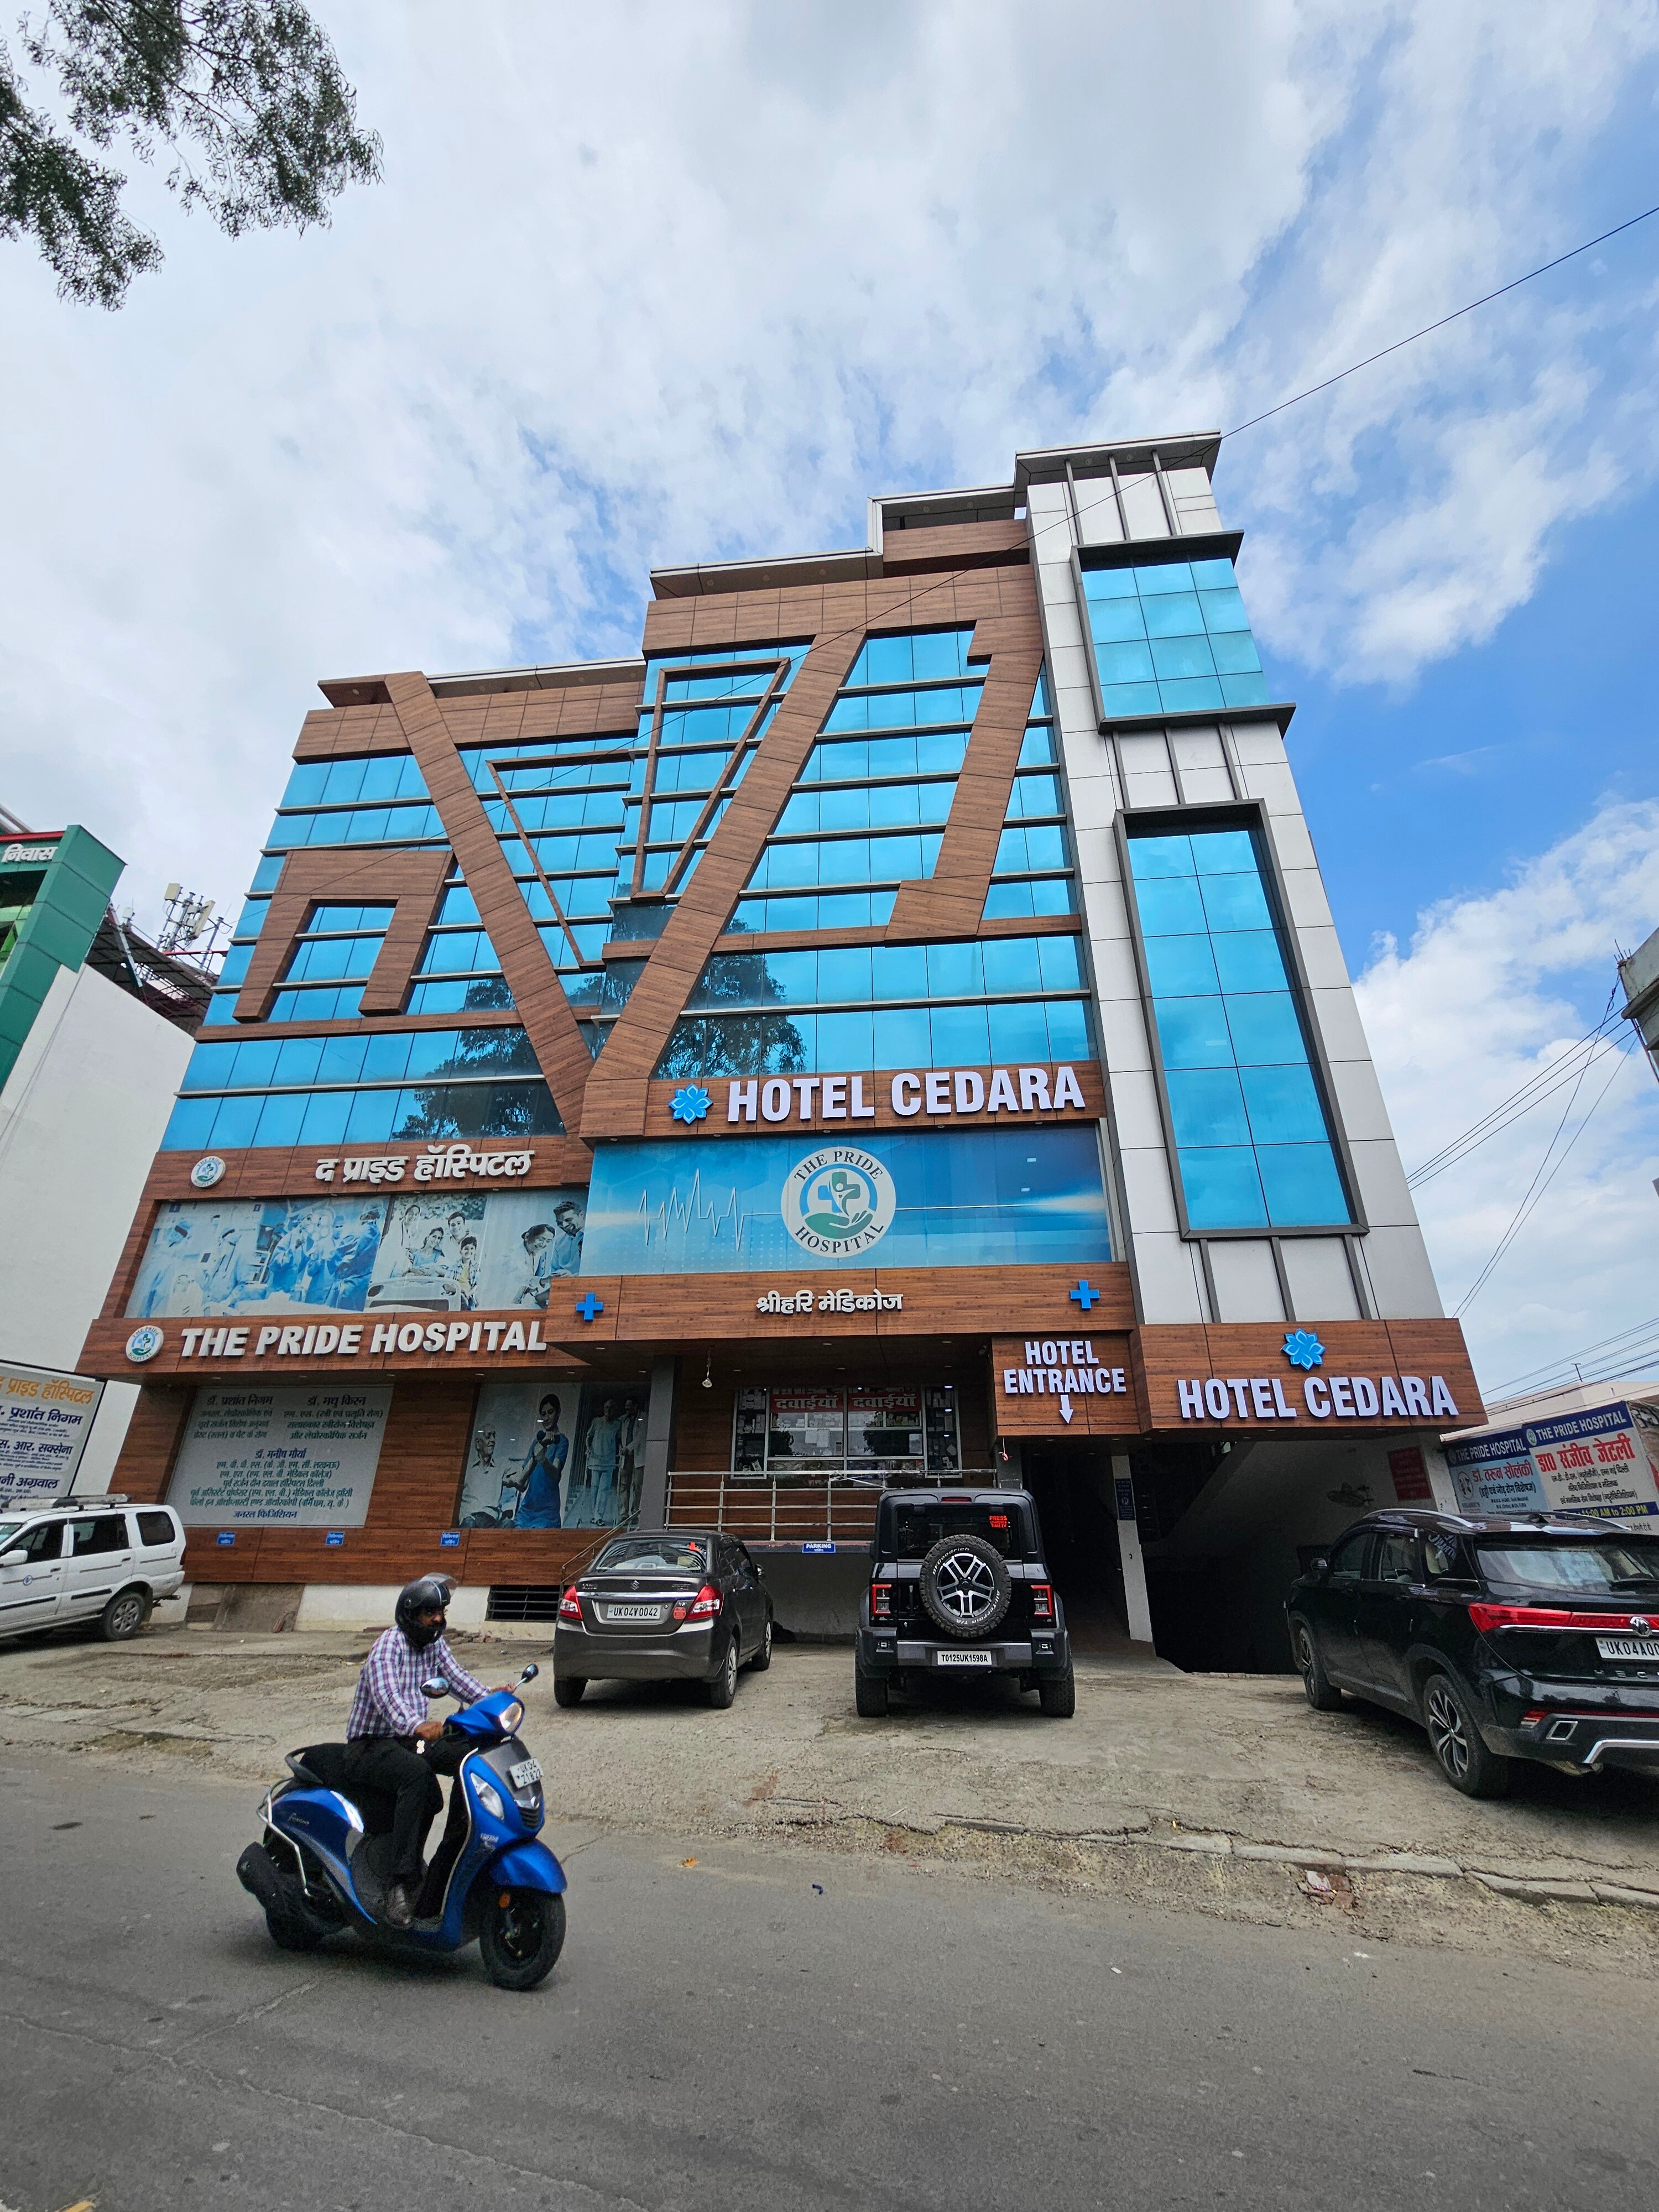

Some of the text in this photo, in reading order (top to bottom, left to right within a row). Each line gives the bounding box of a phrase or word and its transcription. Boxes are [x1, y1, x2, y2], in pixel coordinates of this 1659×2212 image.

[1, 843, 58, 863] निवास
[727, 1066, 1086, 1122] HOTEL CEDARA
[315, 1144, 536, 1184] द प्राइड हॉस्पिटल
[794, 1150, 884, 1182] THE PRIDE
[794, 1224, 885, 1253] HOSPITAL
[756, 1288, 904, 1314] श्रीहरि मेडिकोज
[181, 1320, 547, 1357] THE PRIDE HOSPITAL
[1024, 1339, 1099, 1365] HOTEL
[1003, 1368, 1127, 1395] ENTRANCE
[1177, 1375, 1460, 1419] HOTEL CEDARA
[9, 1406, 46, 1421] प्रशांत
[47, 1408, 84, 1425] निगम
[1535, 1428, 1553, 1441] THE
[1554, 1421, 1580, 1437] PRIDE
[1580, 1410, 1627, 1432] HOSPITAL
[1469, 1444, 1490, 1460] PRIDE
[1490, 1438, 1527, 1457] HOSPITAL
[1557, 1441, 1595, 1469] संजीव
[1592, 1432, 1636, 1463] जेटली
[15, 1477, 60, 1489] अग्रवाल
[1600, 1508, 1611, 1516] AM
[1636, 1504, 1649, 1514] PM
[1594, 1670, 1659, 1678] HEC
